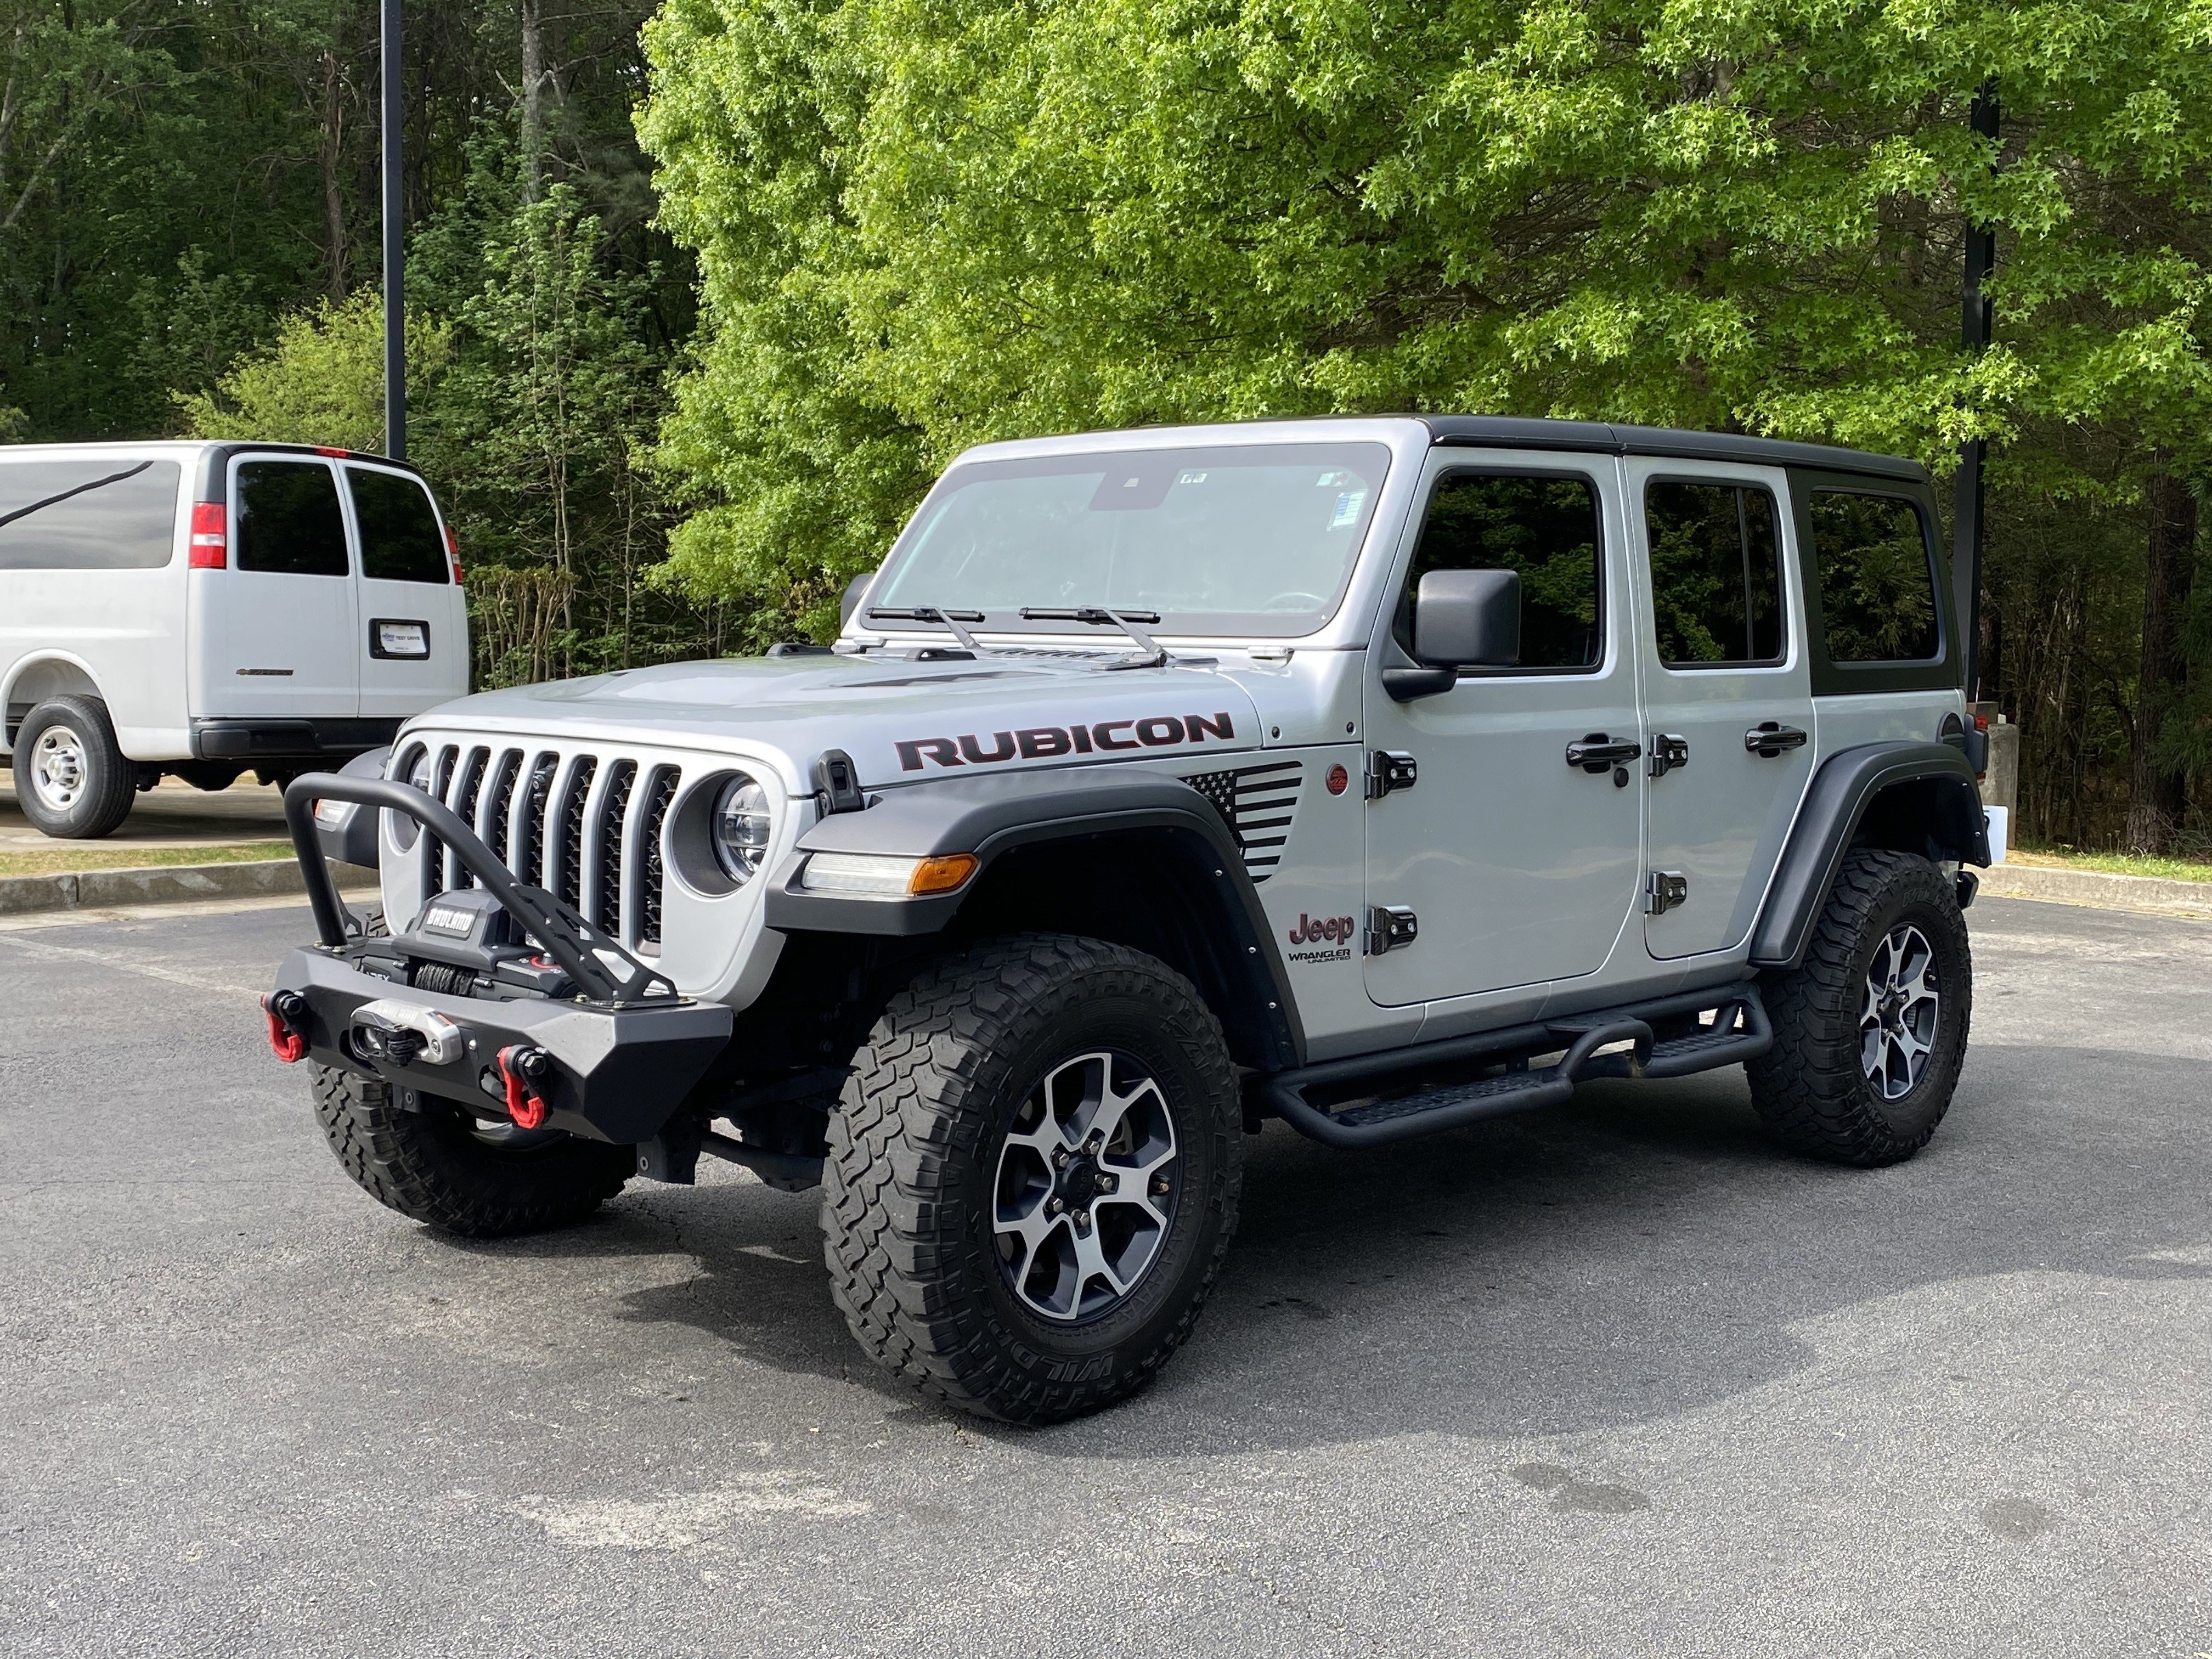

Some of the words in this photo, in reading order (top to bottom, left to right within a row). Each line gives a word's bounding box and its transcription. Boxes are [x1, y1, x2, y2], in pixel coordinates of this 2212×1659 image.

[894, 712, 1235, 771] RUBICON
[426, 908, 475, 932] BADLAND
[1289, 912, 1355, 945] Jeep
[1288, 949, 1350, 961] WRANGLER
[1307, 956, 1351, 964] UNLIMITED
[963, 1204, 1114, 1383] WILDPEAK
